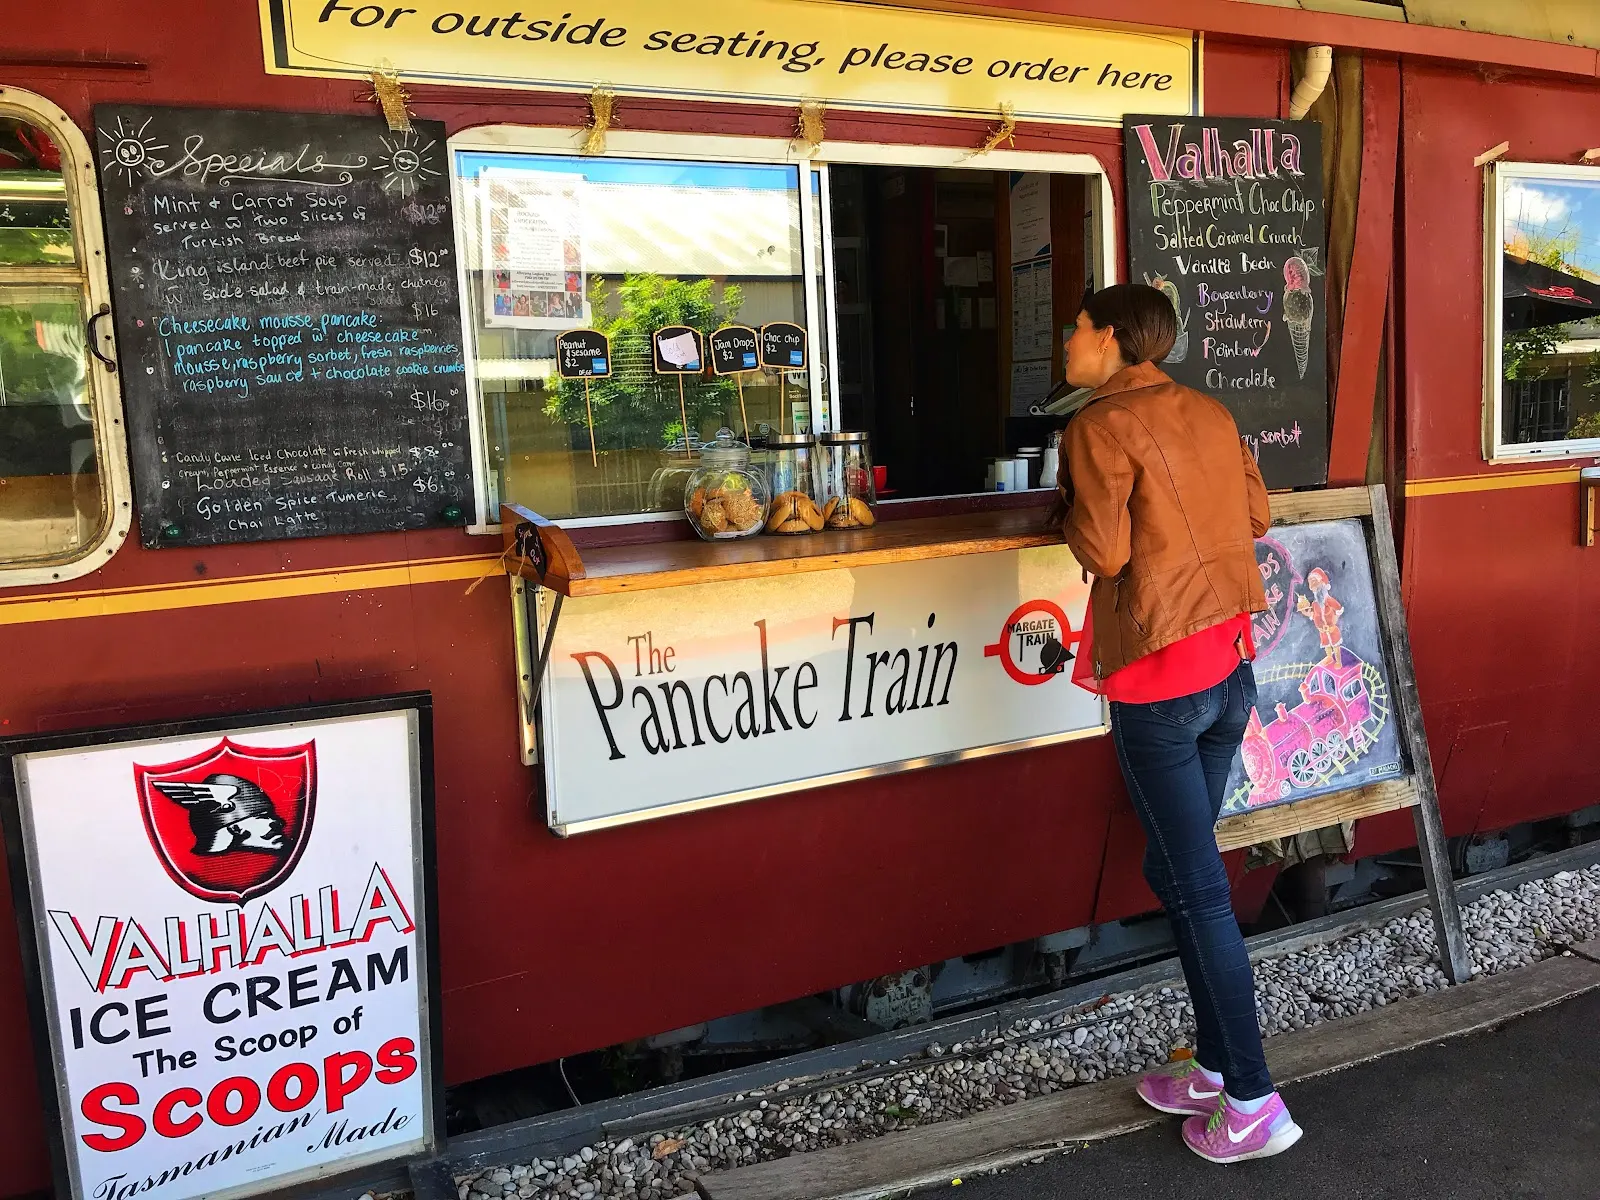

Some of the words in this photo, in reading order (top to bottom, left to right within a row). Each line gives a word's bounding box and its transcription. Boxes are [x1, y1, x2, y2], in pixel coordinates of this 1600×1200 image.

[318, 0, 417, 29] For
[431, 12, 627, 47] outside
[643, 29, 826, 73] seating,
[838, 43, 974, 74] please
[987, 57, 1089, 84] order
[1097, 63, 1173, 91] here
[151, 135, 368, 183] Specials
[1131, 123, 1306, 182] Valhalla
[154, 193, 200, 215] Mint
[232, 192, 294, 211] Carrot
[305, 192, 347, 208] Soup
[1150, 178, 1245, 231] Peppermint
[1249, 182, 1280, 215] Choc
[153, 218, 211, 235] served
[300, 210, 344, 221] Slices
[352, 206, 366, 220] of
[181, 234, 243, 250] Turkish
[255, 232, 301, 244] Bread
[1154, 224, 1204, 250] Salted
[1206, 223, 1254, 249] Caramel
[1259, 224, 1306, 247] Crunch
[153, 258, 210, 285] King
[217, 253, 273, 273] island
[278, 249, 309, 268] beef
[315, 254, 337, 272] pie
[349, 253, 396, 267] served
[1173, 254, 1231, 274] Vanilla
[1239, 251, 1277, 274] Bean
[202, 282, 244, 300] side
[249, 281, 290, 297] salad
[316, 277, 394, 296] train-made
[401, 275, 448, 295] chutney
[1196, 283, 1274, 314] Boysenberry
[160, 312, 251, 337] Cheesecake
[260, 314, 313, 330] mousse
[1205, 308, 1271, 347] Strawberry
[177, 338, 242, 361] pancake
[252, 330, 303, 352] topped
[337, 329, 419, 344] cheesecake
[361, 345, 392, 360] fresh
[560, 339, 586, 349] Peanut
[571, 348, 602, 357] sesame
[714, 339, 731, 351] Jam
[733, 337, 755, 351] Drops
[723, 349, 734, 361] $2
[766, 343, 777, 354] $2
[1202, 337, 1262, 366] Rainbow
[565, 357, 579, 368] $2
[182, 375, 249, 399] raspberry
[256, 370, 304, 386] sauce
[326, 364, 391, 380] chocolate
[397, 361, 430, 375] cookie
[434, 360, 465, 373] crumbs
[1205, 368, 1276, 389] Chocolate
[176, 452, 212, 465] Candy
[214, 451, 242, 462] Cane
[249, 448, 272, 461] Iced
[276, 445, 327, 460] Chocolate
[344, 447, 369, 456] fresh
[372, 445, 401, 458] whipped
[196, 473, 271, 492] Loaded
[280, 472, 340, 488] Sausage
[345, 467, 372, 481] Roll
[213, 464, 260, 479] Peppermint
[263, 463, 298, 474] Essence
[196, 497, 263, 520] Golden
[275, 492, 317, 511] Spice
[229, 518, 263, 530] Chai
[274, 511, 319, 526] Latte
[1007, 619, 1055, 633] MARGATE
[627, 630, 676, 678] The
[1017, 630, 1055, 662] TRAIN
[570, 618, 819, 762] Pancake
[831, 611, 959, 723] Train
[47, 861, 416, 994] VALHALLA
[69, 994, 171, 1050] ICE
[203, 945, 409, 1026] CREAM
[132, 1048, 197, 1078] The
[214, 1025, 318, 1062] Scoop
[333, 1006, 363, 1036] of
[81, 1037, 418, 1153] Scoops
[93, 1107, 322, 1200] Tasmanian
[306, 1107, 416, 1153] Made
